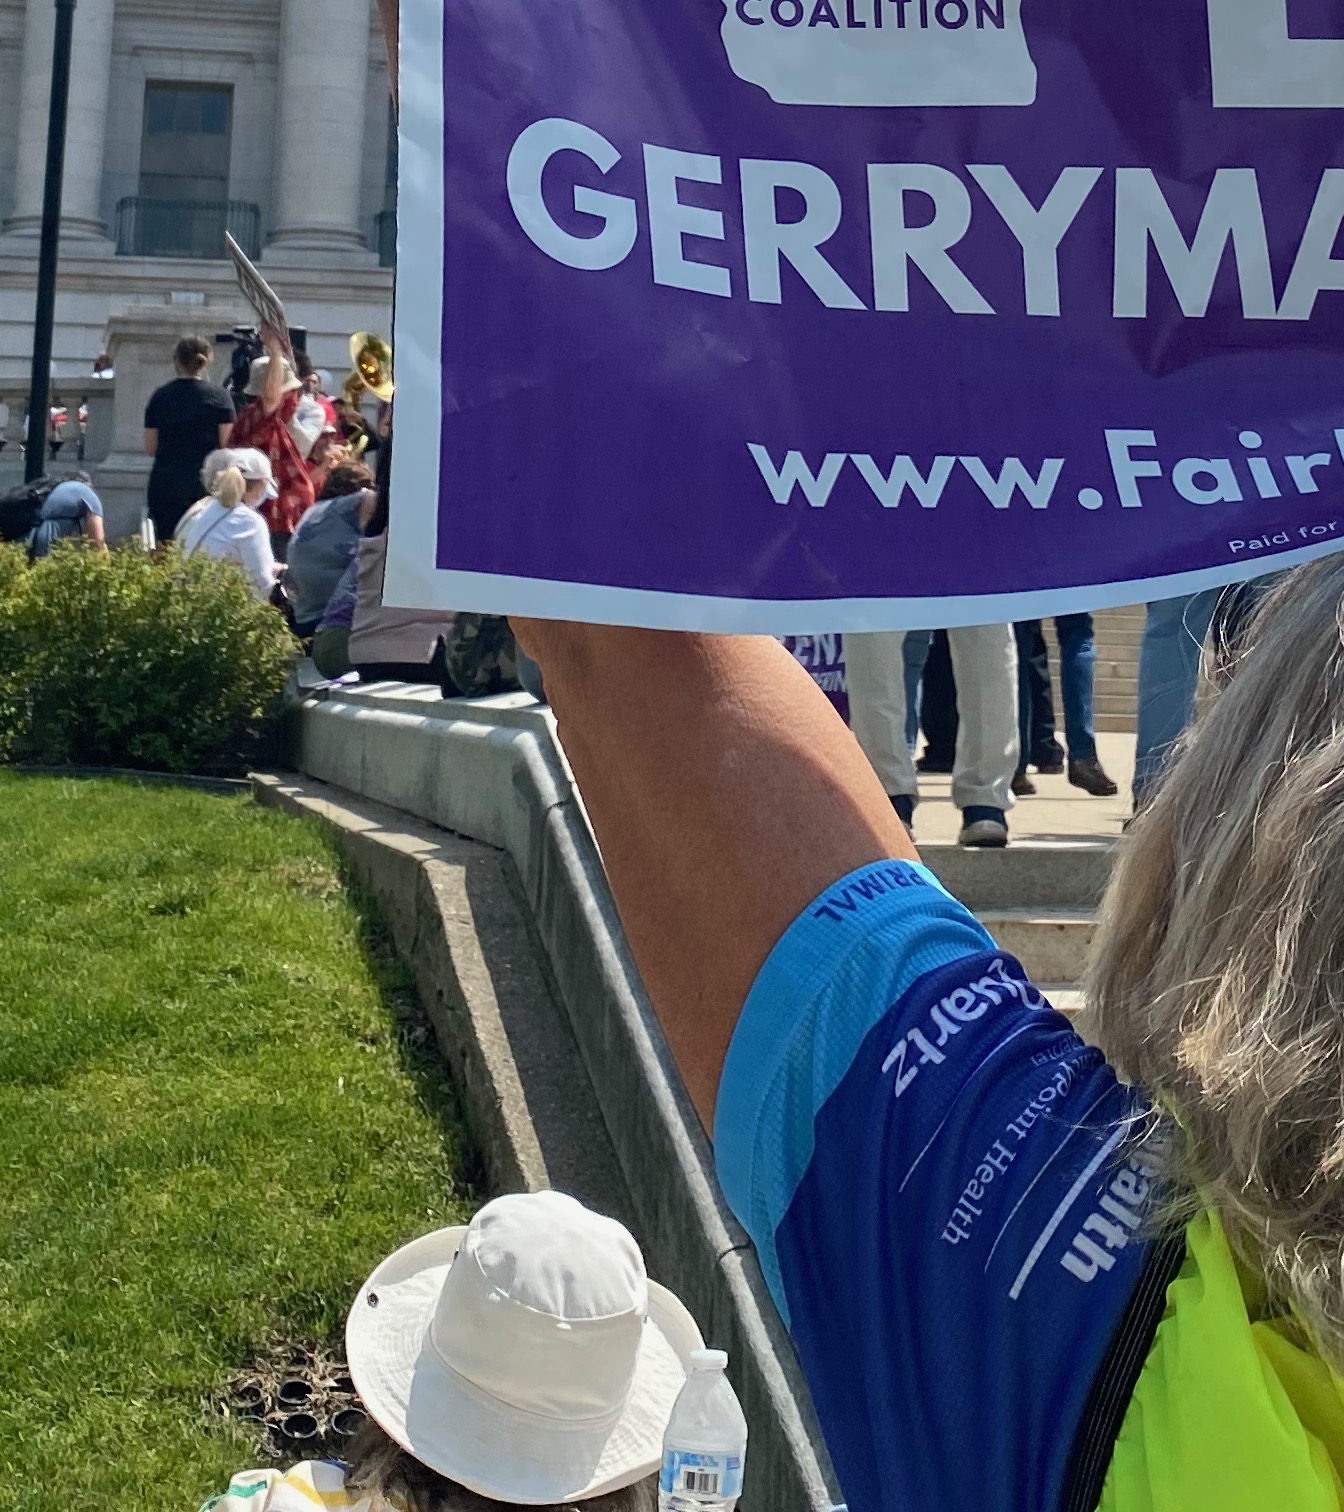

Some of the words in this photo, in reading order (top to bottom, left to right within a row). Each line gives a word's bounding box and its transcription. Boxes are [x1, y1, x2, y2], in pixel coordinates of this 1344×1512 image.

[1228, 531, 1290, 553] Paid
[1298, 521, 1338, 538] for
[813, 867, 928, 921] PRIMAL
[942, 1139, 1017, 1245] Health
